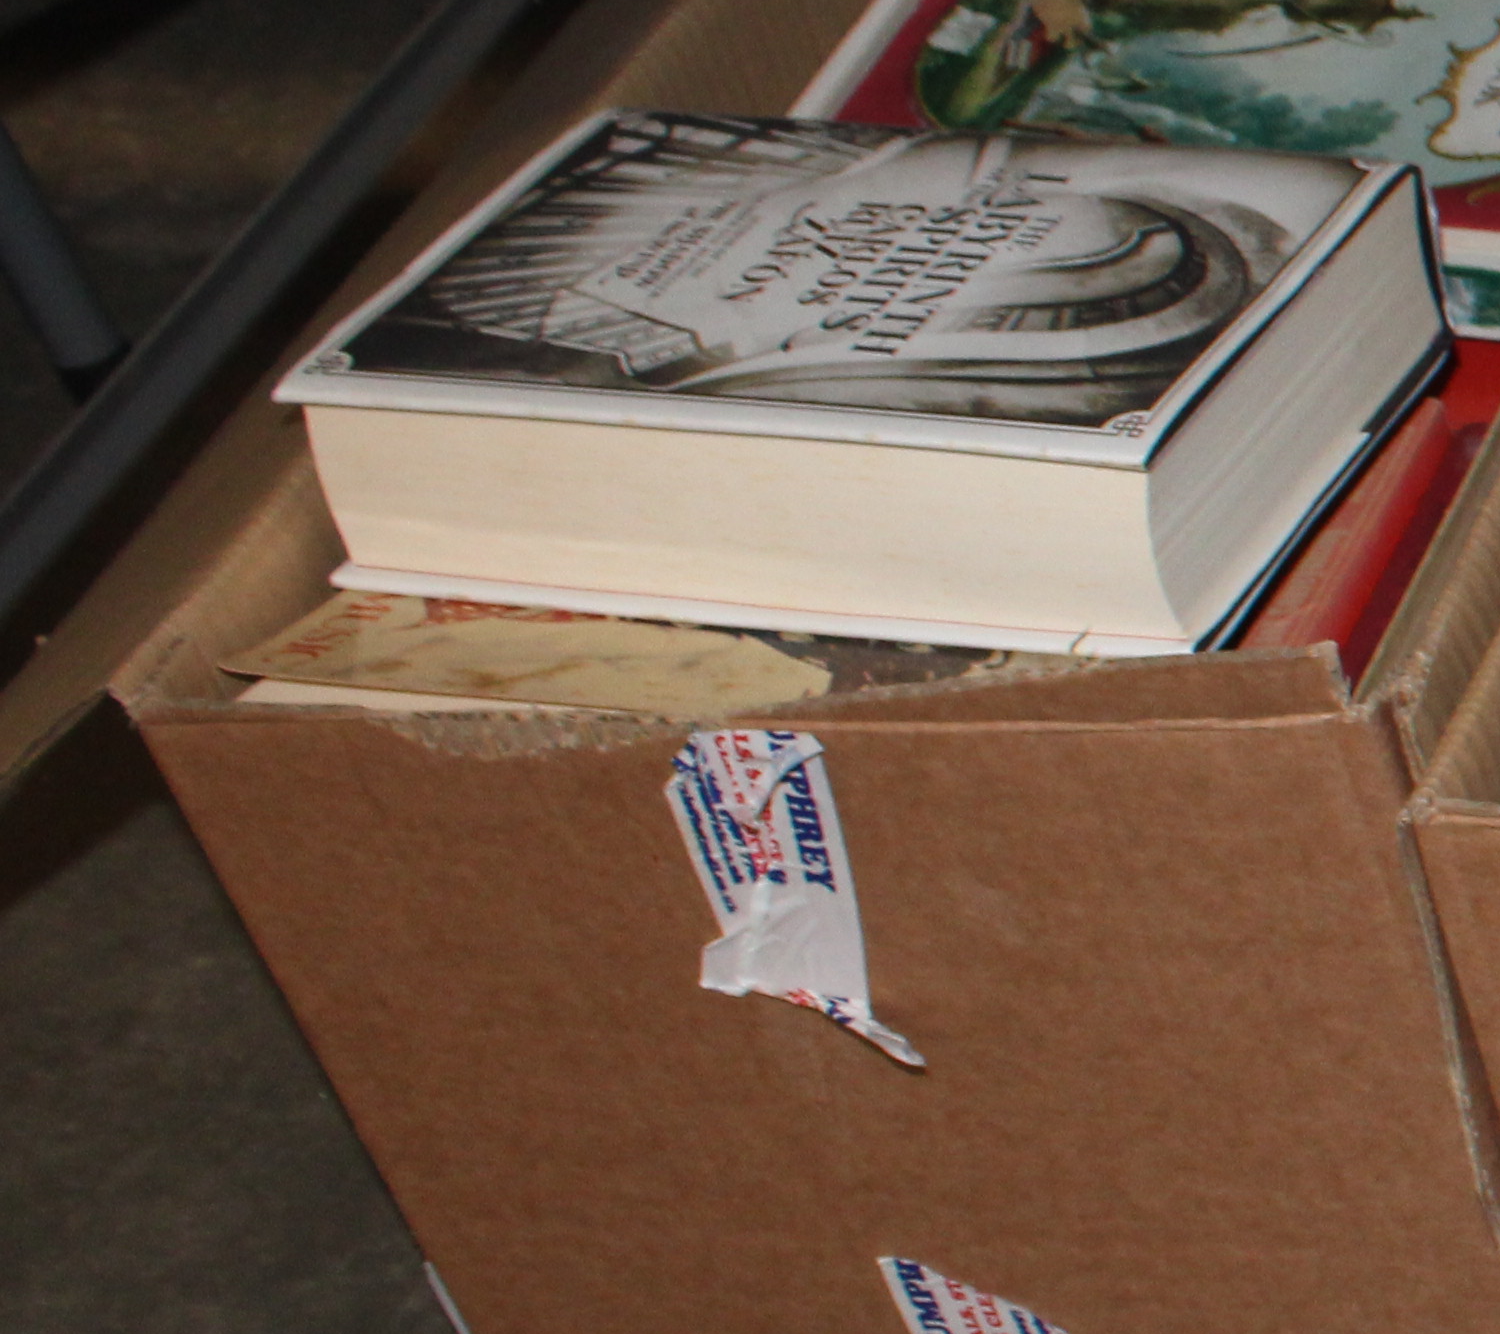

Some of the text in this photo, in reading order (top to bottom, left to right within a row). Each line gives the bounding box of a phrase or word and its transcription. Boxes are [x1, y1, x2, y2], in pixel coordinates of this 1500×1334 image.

[797, 203, 928, 305] CARLOS
[818, 204, 978, 332] SPIRITS
[851, 170, 1072, 355] LABYRINTH
